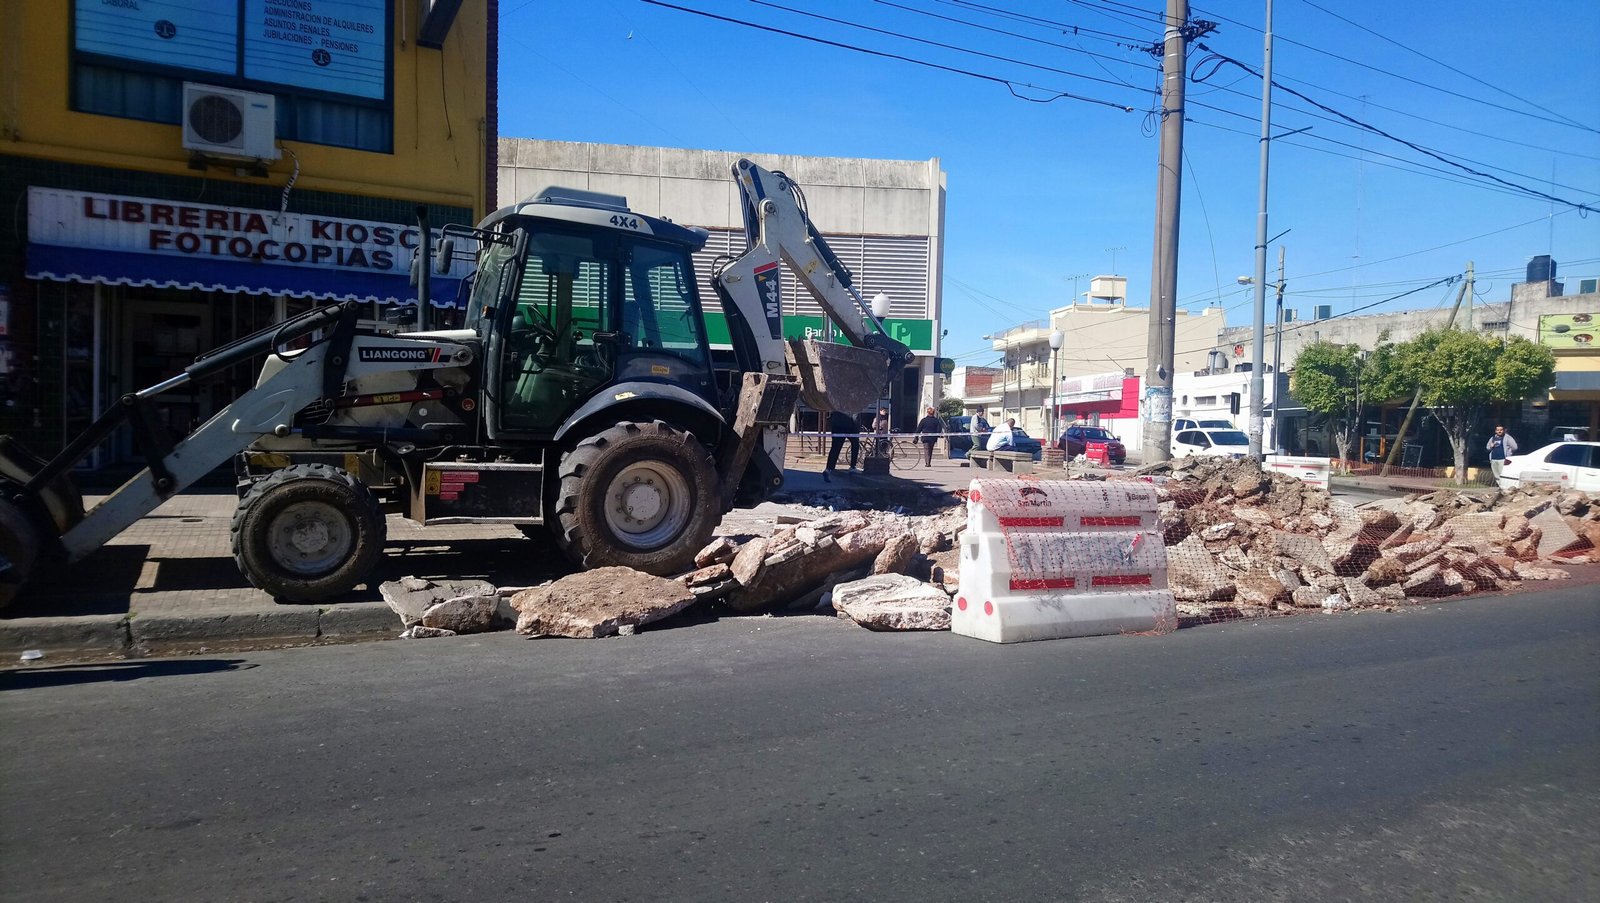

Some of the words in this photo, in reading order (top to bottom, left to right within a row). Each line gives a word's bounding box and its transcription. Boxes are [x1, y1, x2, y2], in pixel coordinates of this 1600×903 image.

[264, 7, 321, 25] ADMINISTRACION
[322, 17, 332, 26] DE
[333, 18, 375, 34] ALQUILERES
[264, 18, 296, 31] ASUNTOS
[299, 23, 330, 37] PENALES
[263, 30, 313, 45] JUBILACIONES
[320, 38, 359, 53] PENSIONES
[84, 197, 269, 234] LIBRERIA
[312, 219, 442, 250] KIOSC
[609, 215, 638, 229] 4X4
[149, 229, 394, 270] FOTOCOPIAS
[766, 279, 778, 318] M44
[362, 350, 426, 359] LIANGONG
